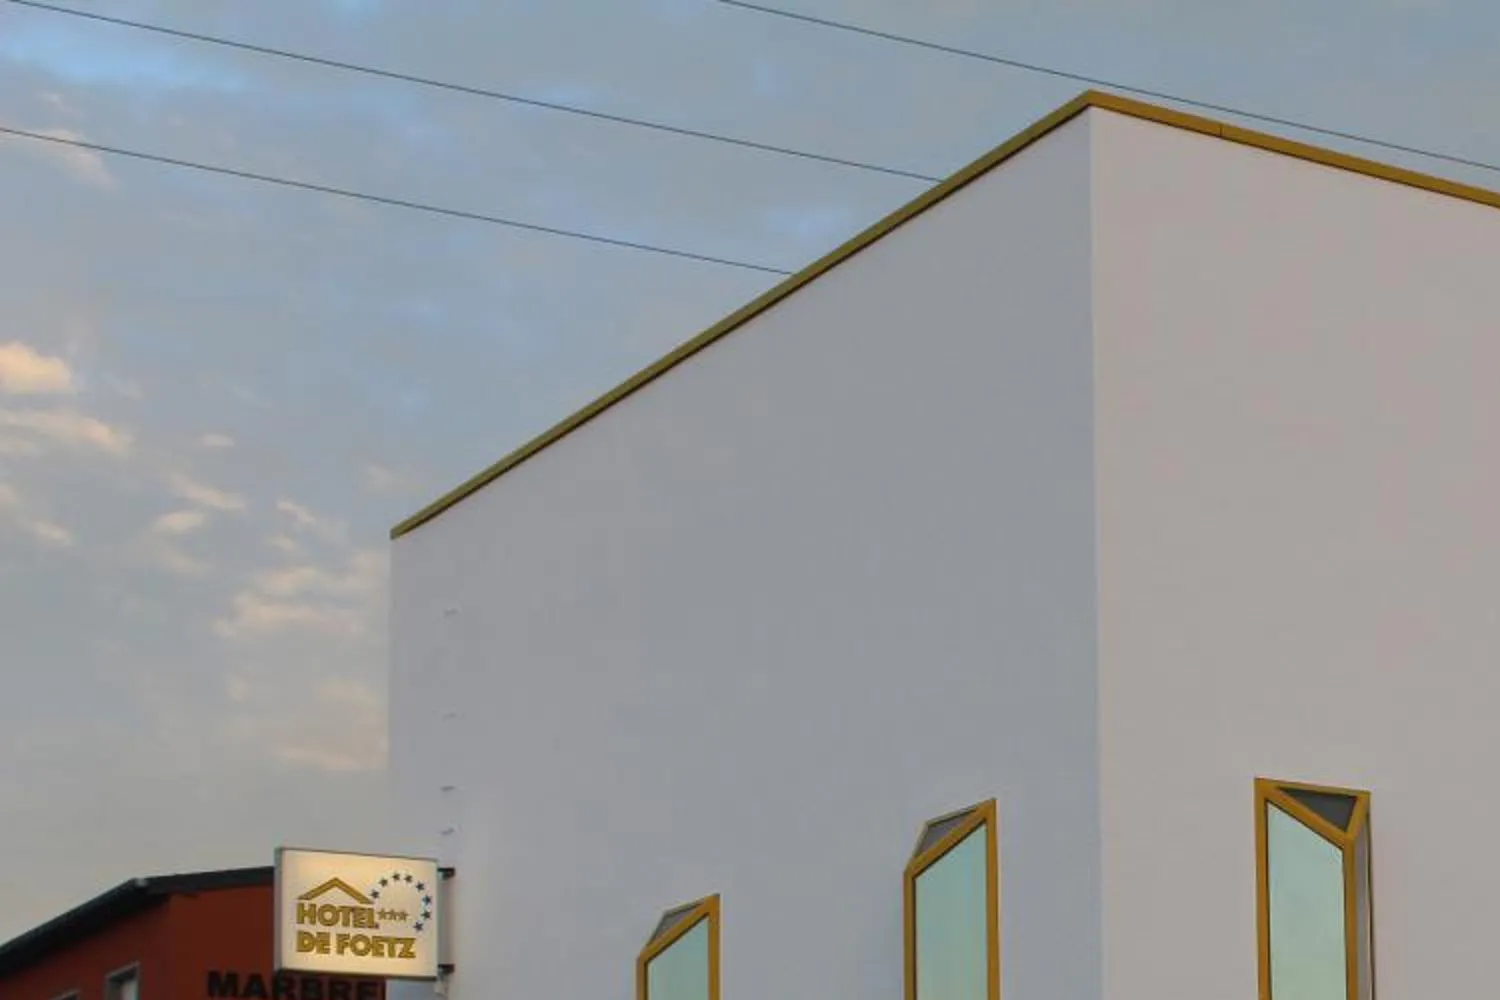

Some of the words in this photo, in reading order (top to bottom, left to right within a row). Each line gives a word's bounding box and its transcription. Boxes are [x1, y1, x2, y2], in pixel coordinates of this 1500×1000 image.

[296, 903, 378, 929] HOTEL
[296, 931, 331, 955] DE
[336, 934, 416, 959] FOETZ
